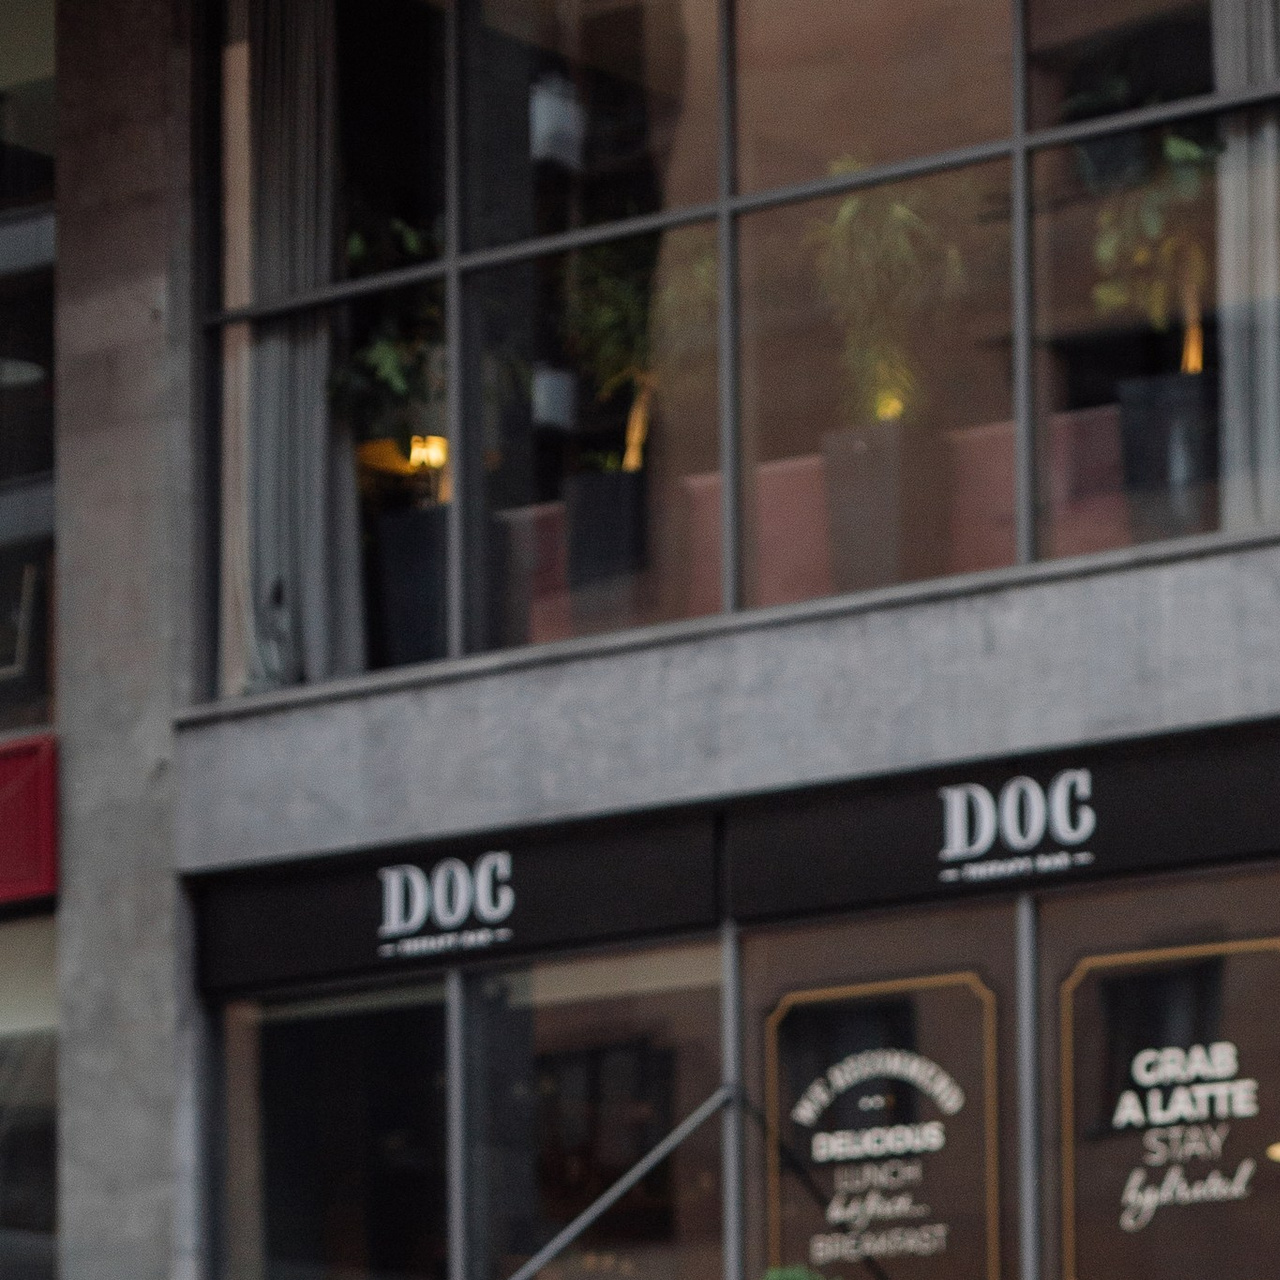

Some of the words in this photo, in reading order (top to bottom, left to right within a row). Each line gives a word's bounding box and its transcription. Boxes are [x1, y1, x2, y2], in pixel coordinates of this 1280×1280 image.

[937, 768, 1096, 862] DOC
[377, 851, 515, 938] DOC
[1131, 1041, 1238, 1087] GRAB
[1112, 1089, 1146, 1129] A
[1147, 1078, 1259, 1125] LATTE
[812, 1121, 945, 1162] DELICIOUS
[1142, 1123, 1230, 1166] STAY
[833, 1160, 923, 1192] LUNCH
[810, 1224, 947, 1266] BREAKFAST
